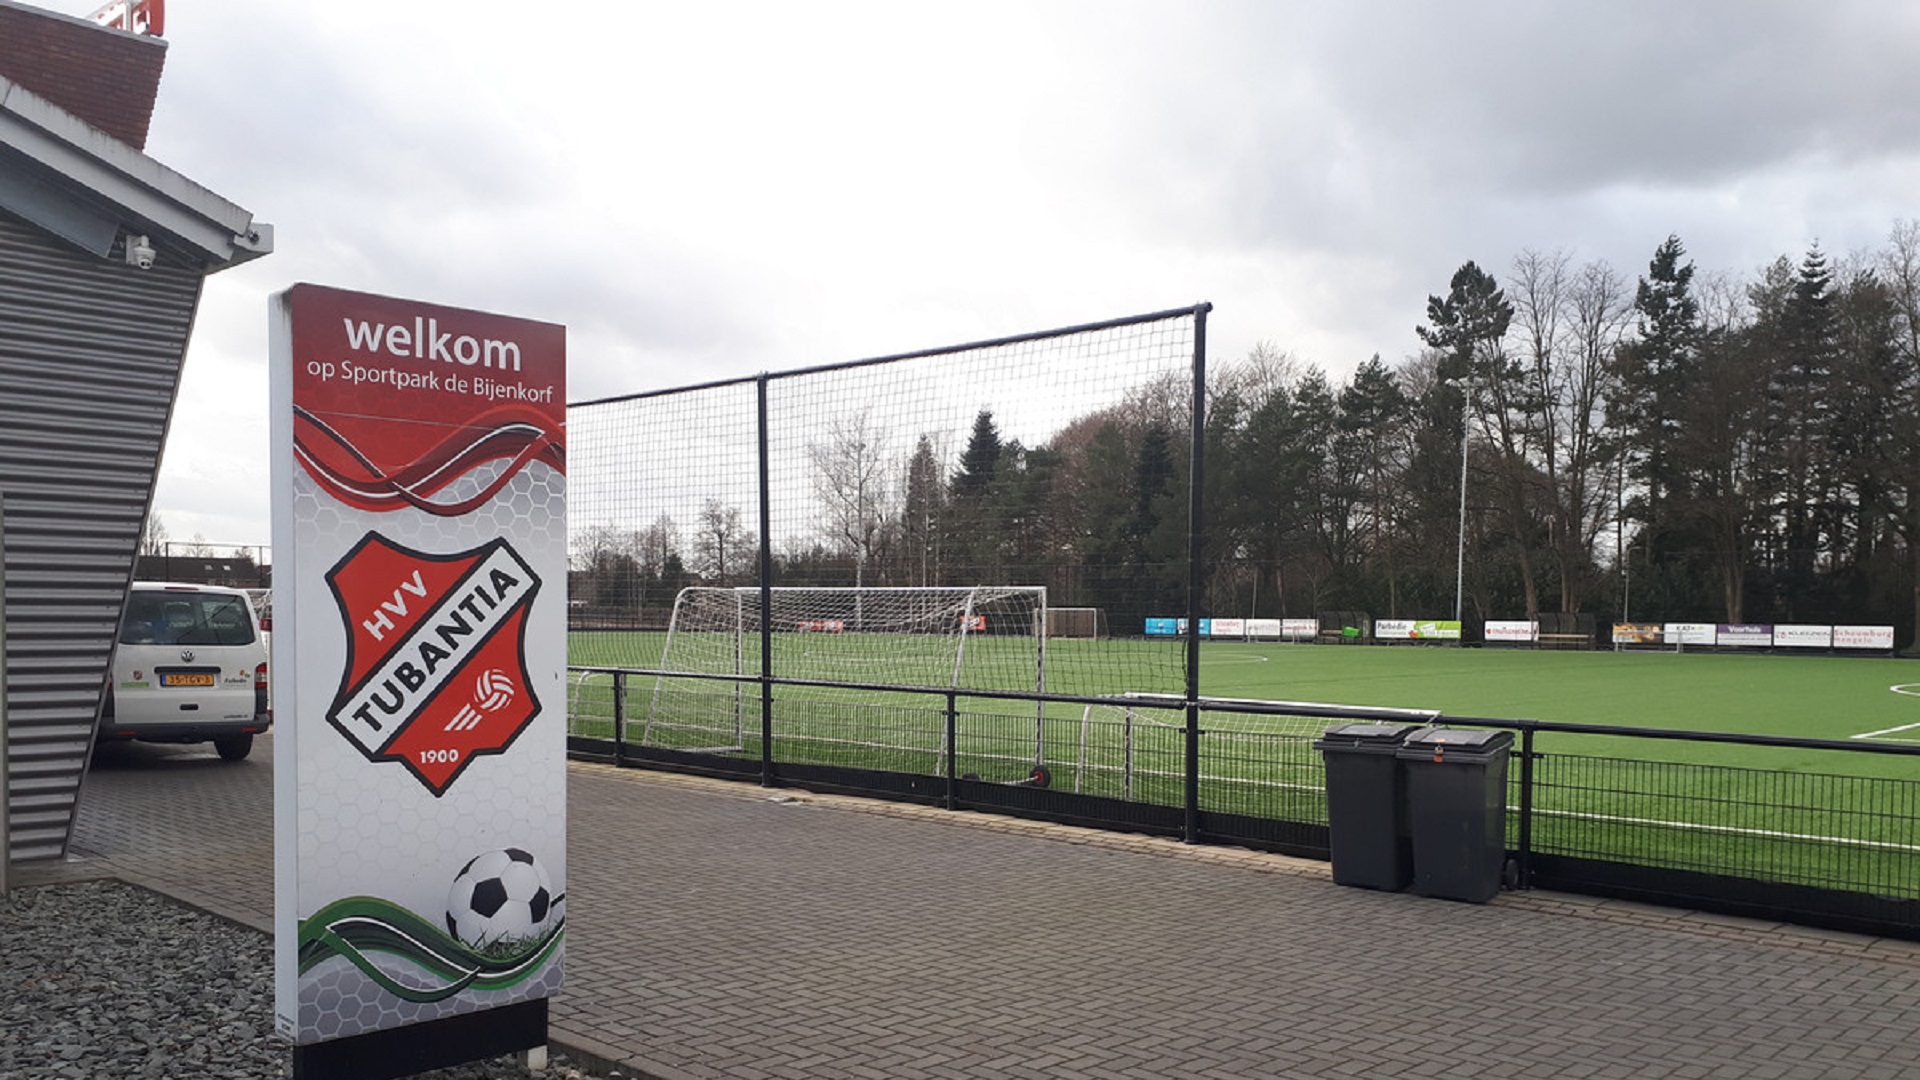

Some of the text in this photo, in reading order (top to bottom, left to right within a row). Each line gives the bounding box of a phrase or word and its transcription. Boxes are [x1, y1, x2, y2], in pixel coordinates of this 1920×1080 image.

[343, 317, 521, 371] welkom
[307, 360, 553, 403] op Sportpark de Bijenkorf
[362, 570, 428, 641] HVV
[1727, 625, 1762, 634] Voorhuis
[351, 568, 520, 732] TUBANTIA
[420, 749, 459, 764] 1900
